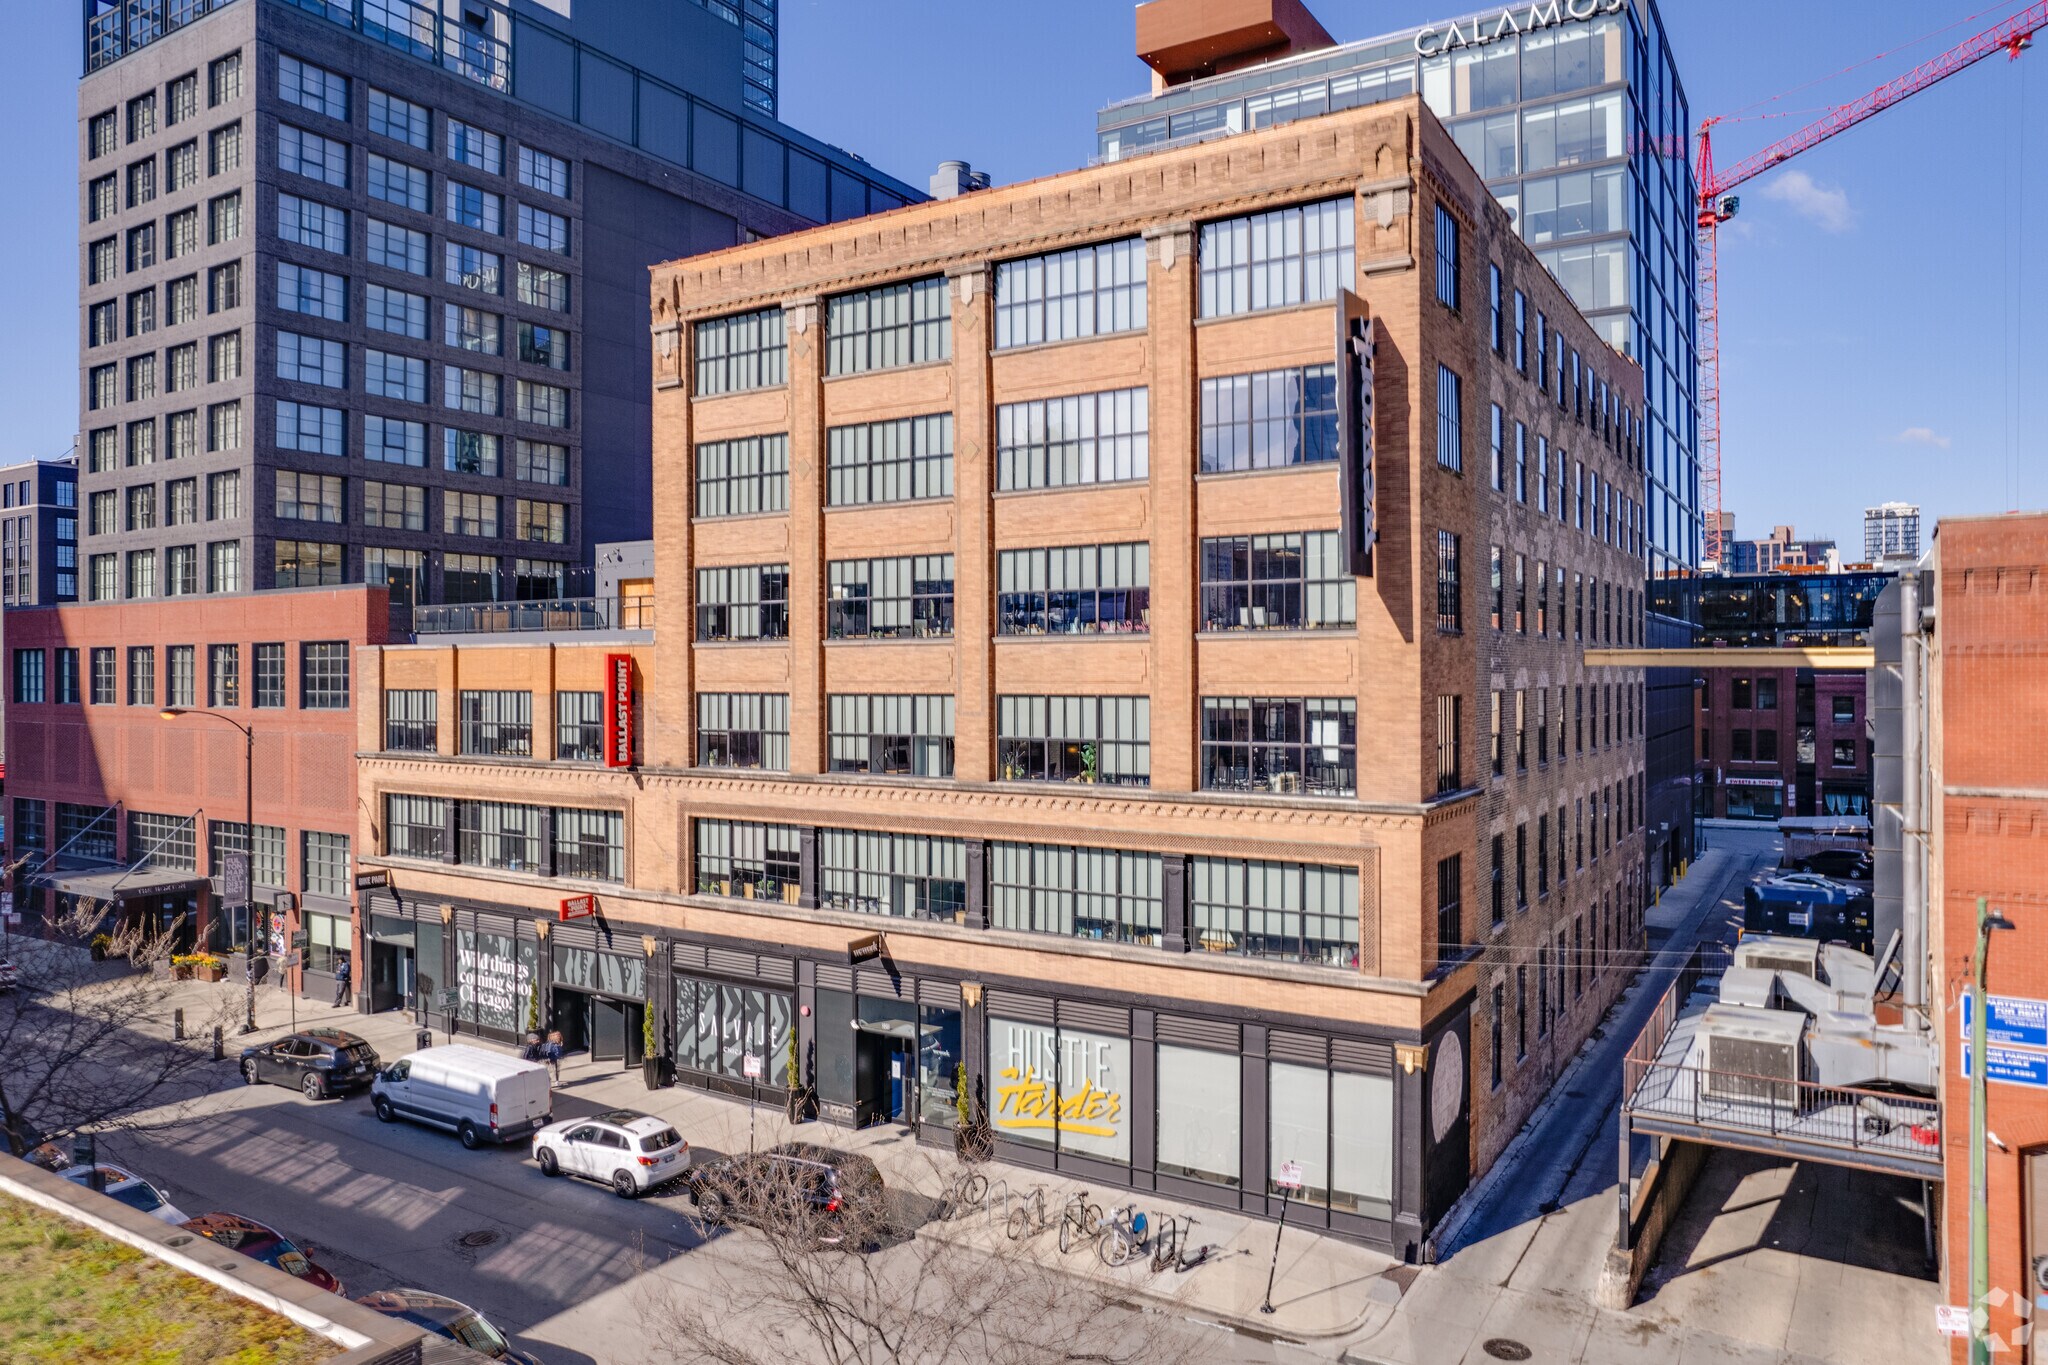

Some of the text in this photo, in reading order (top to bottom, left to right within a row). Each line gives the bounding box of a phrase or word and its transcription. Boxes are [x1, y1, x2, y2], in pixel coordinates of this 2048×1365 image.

[617, 659, 628, 762] BALLAST POINT
[226, 857, 239, 866] FUL
[226, 880, 244, 888] DIST
[226, 886, 243, 894] RICT
[358, 874, 386, 886] BIKE PARK
[853, 942, 878, 957] wework
[460, 949, 529, 981] Wild things
[460, 971, 505, 995] coming
[460, 984, 512, 1012] Chicago!
[699, 1012, 777, 1048] SALVAJE
[1008, 1026, 1111, 1094] HUSTLE
[997, 1064, 1122, 1123] Harder
